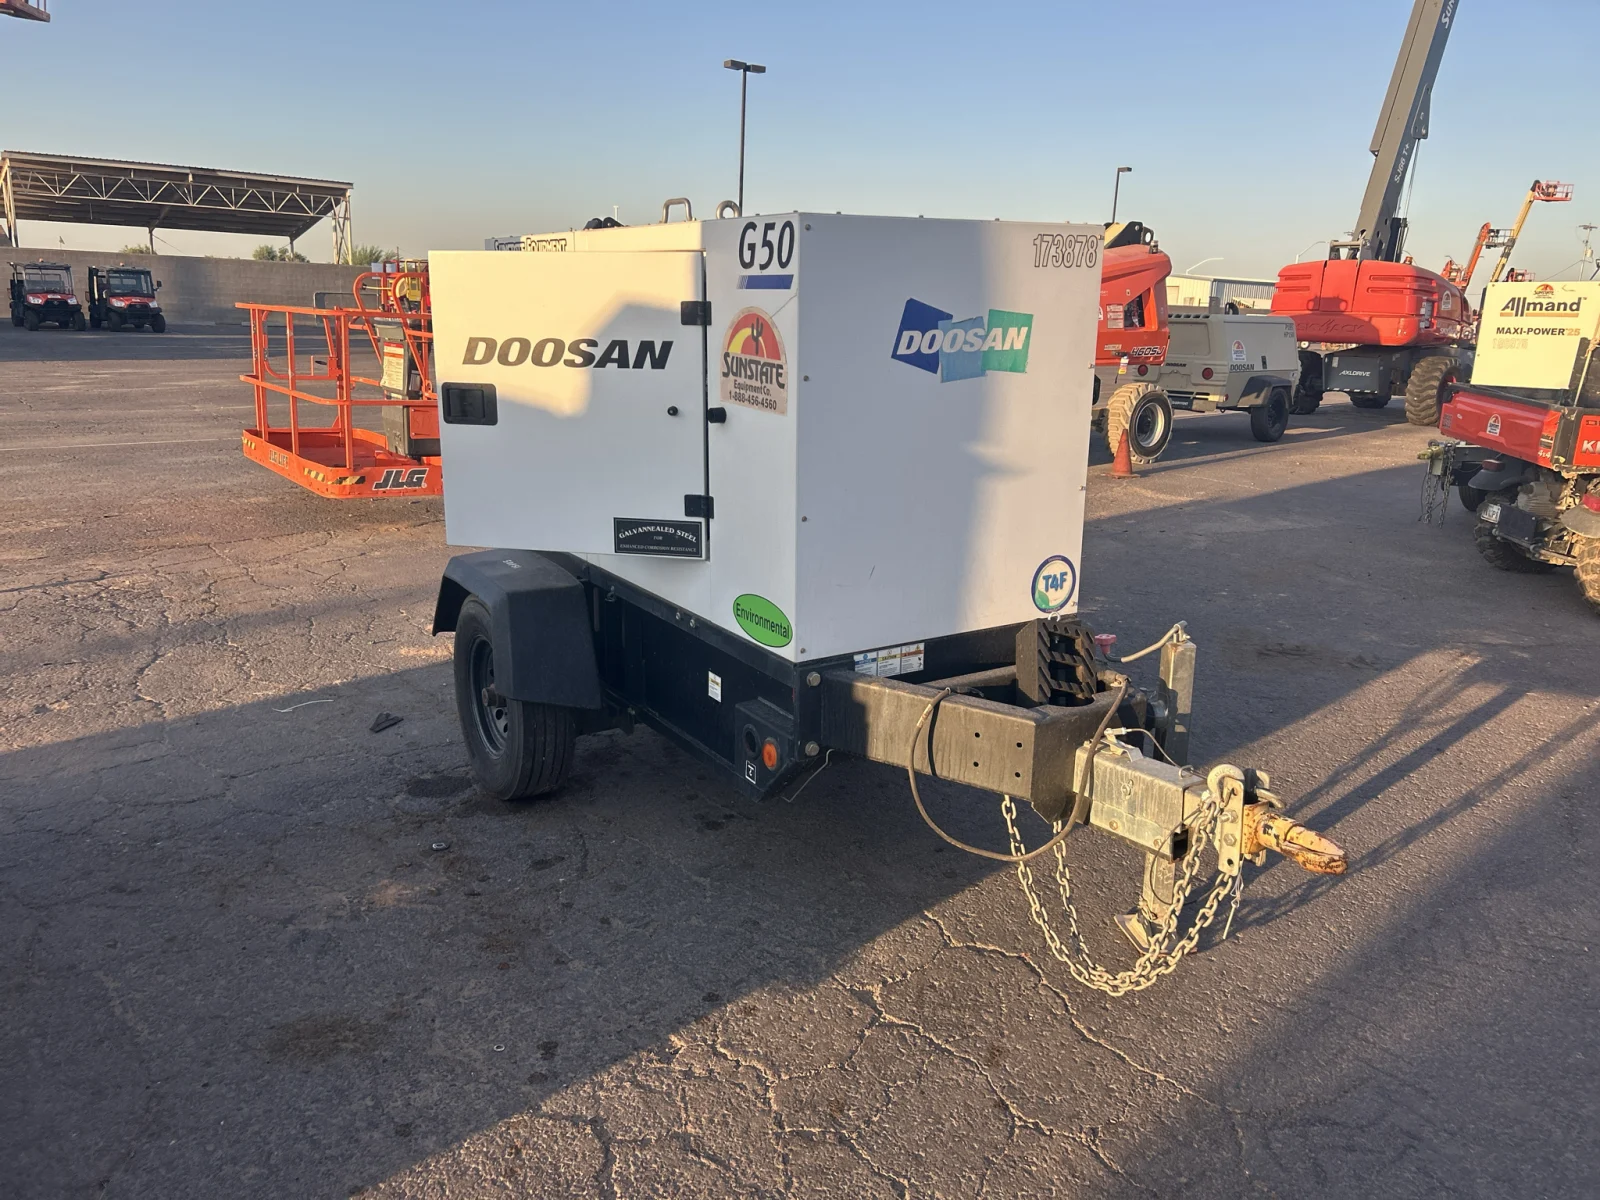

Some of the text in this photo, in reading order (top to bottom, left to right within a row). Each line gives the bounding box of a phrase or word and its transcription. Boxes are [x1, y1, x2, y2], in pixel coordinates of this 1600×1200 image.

[739, 220, 795, 270] G50
[1033, 234, 1098, 268] 173878
[1501, 297, 1582, 317] Allmand
[896, 327, 1028, 355] DOOSAN
[1496, 327, 1580, 336] MAXI-POWER 25
[462, 336, 673, 370] DOOSAN
[722, 352, 785, 389] SUNSTATE
[1230, 363, 1255, 371] DOOSAN
[729, 390, 777, 410] 1-888-456-4560
[373, 468, 429, 490] JLG
[618, 525, 697, 543] GALVANNEALED STEEL
[736, 602, 790, 640] Environmental
